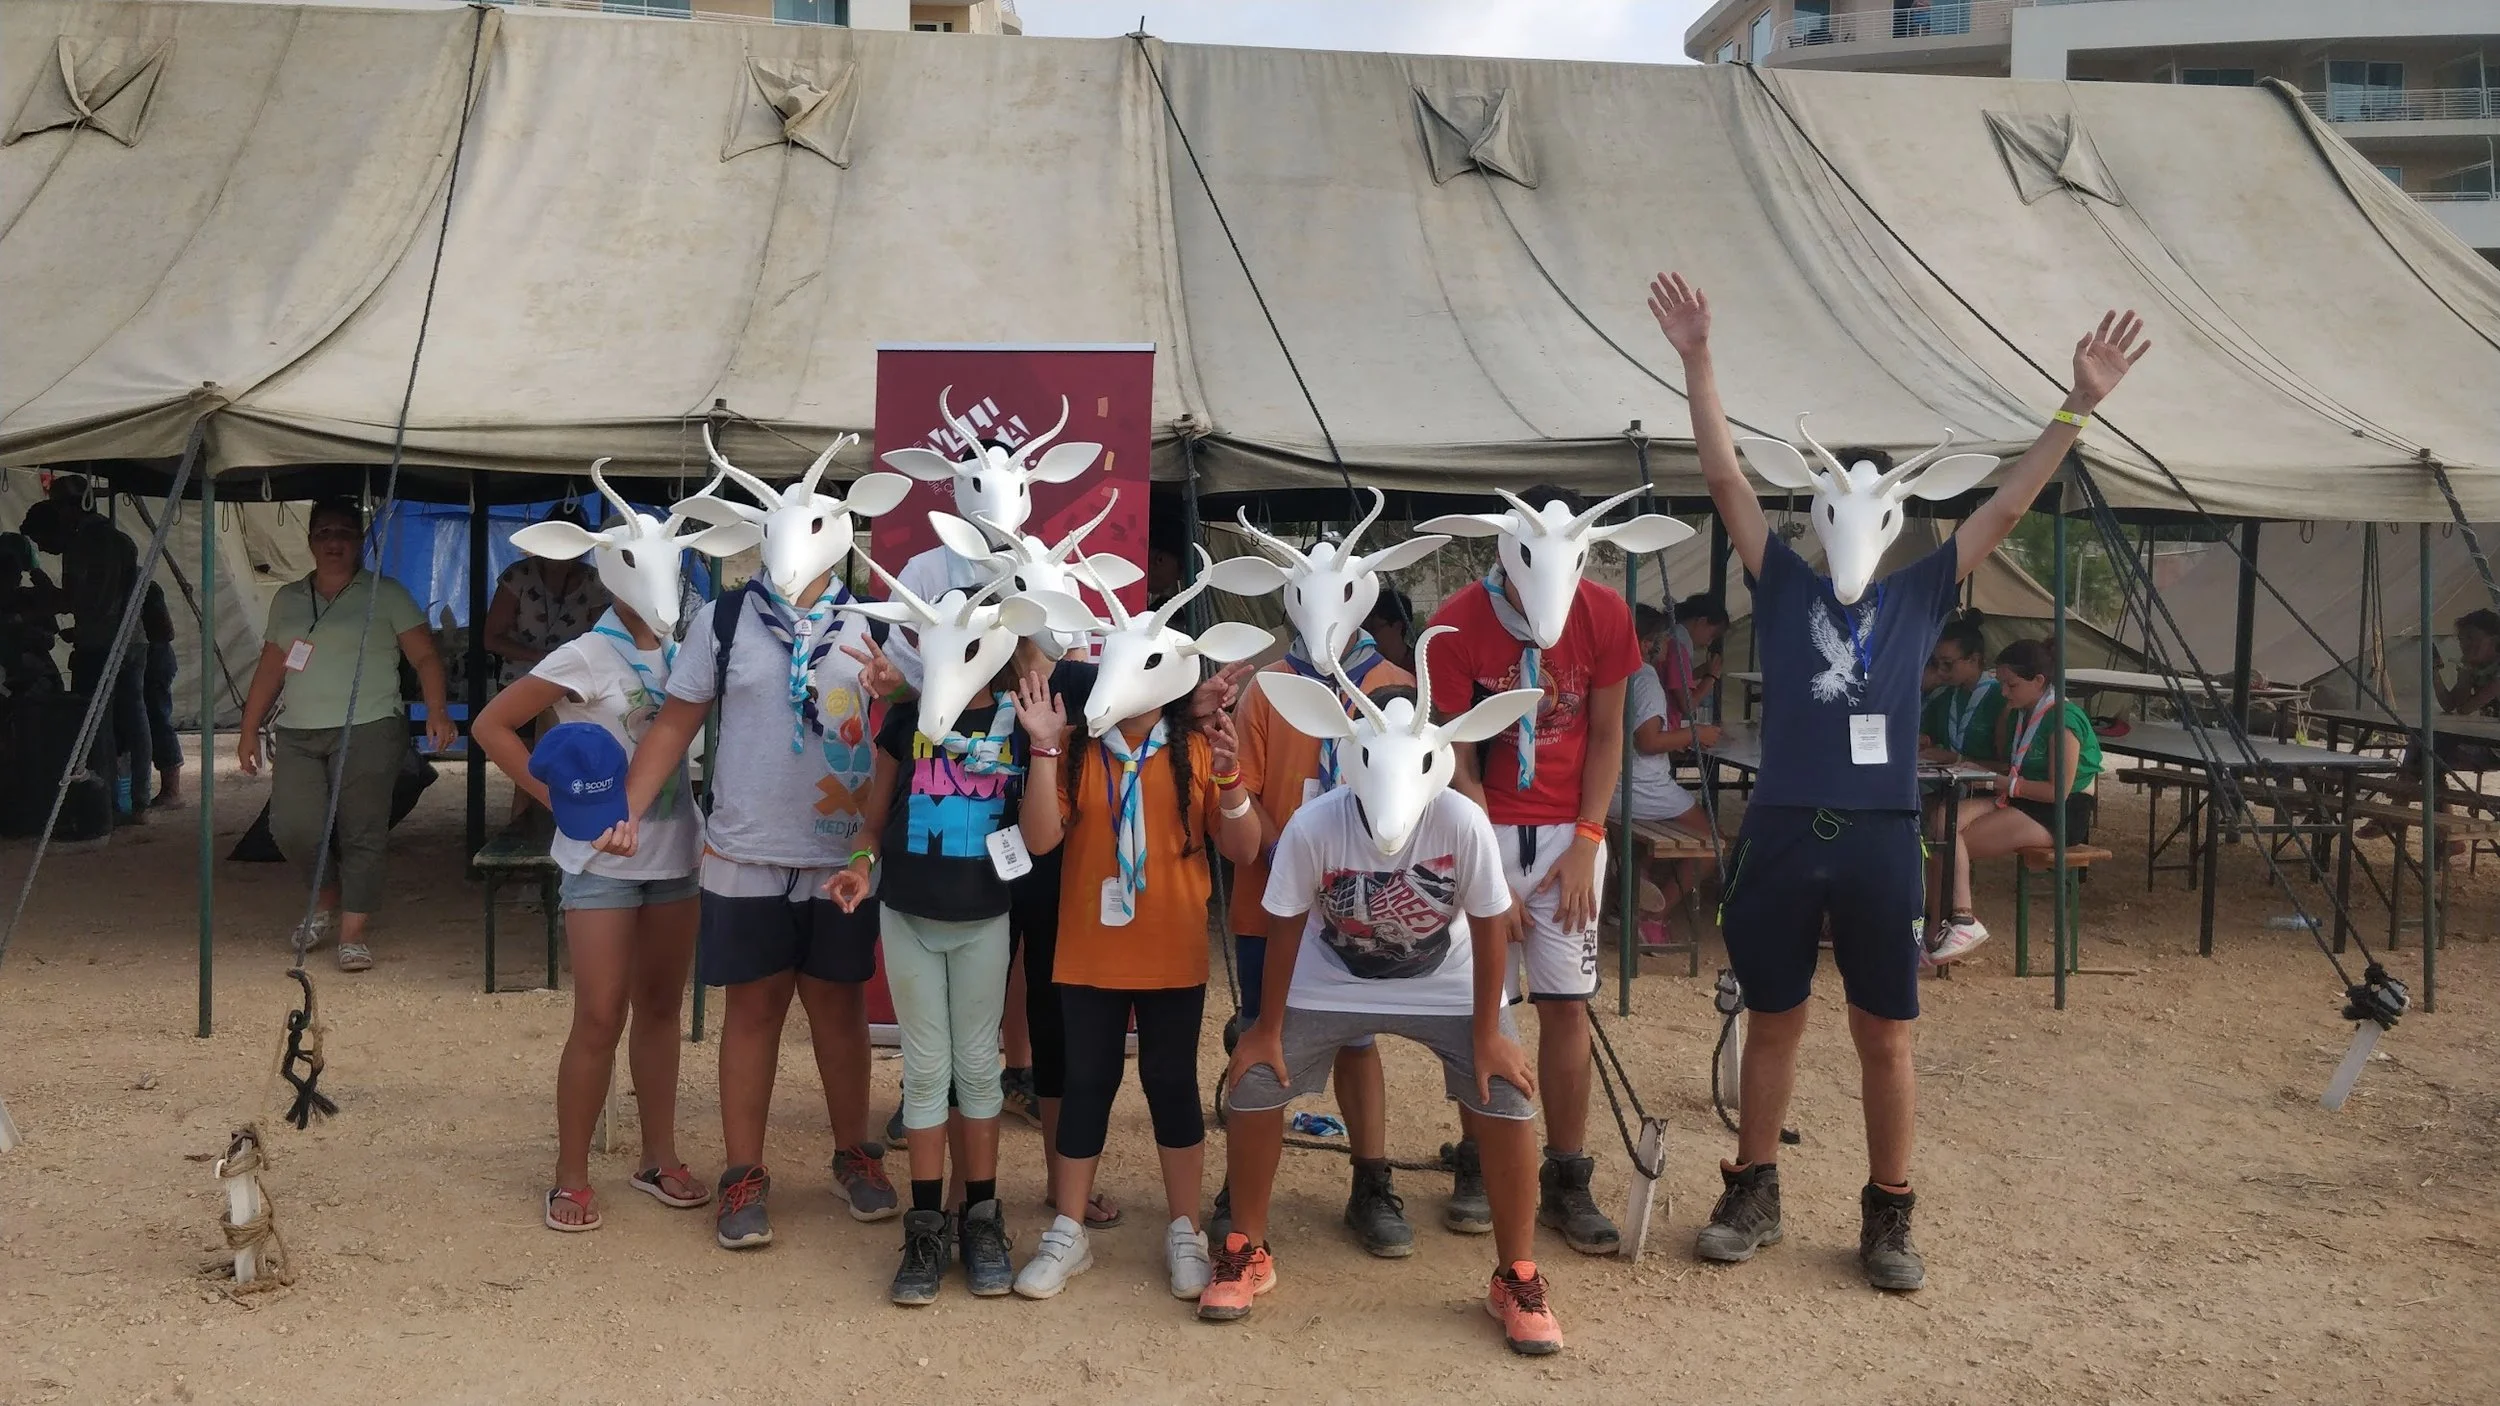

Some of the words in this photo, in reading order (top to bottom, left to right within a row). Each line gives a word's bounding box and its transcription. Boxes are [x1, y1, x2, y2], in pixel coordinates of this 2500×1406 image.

[814, 818, 863, 838] MEDJA
[907, 793, 1006, 857] ME
[1385, 870, 1450, 934] STREET
